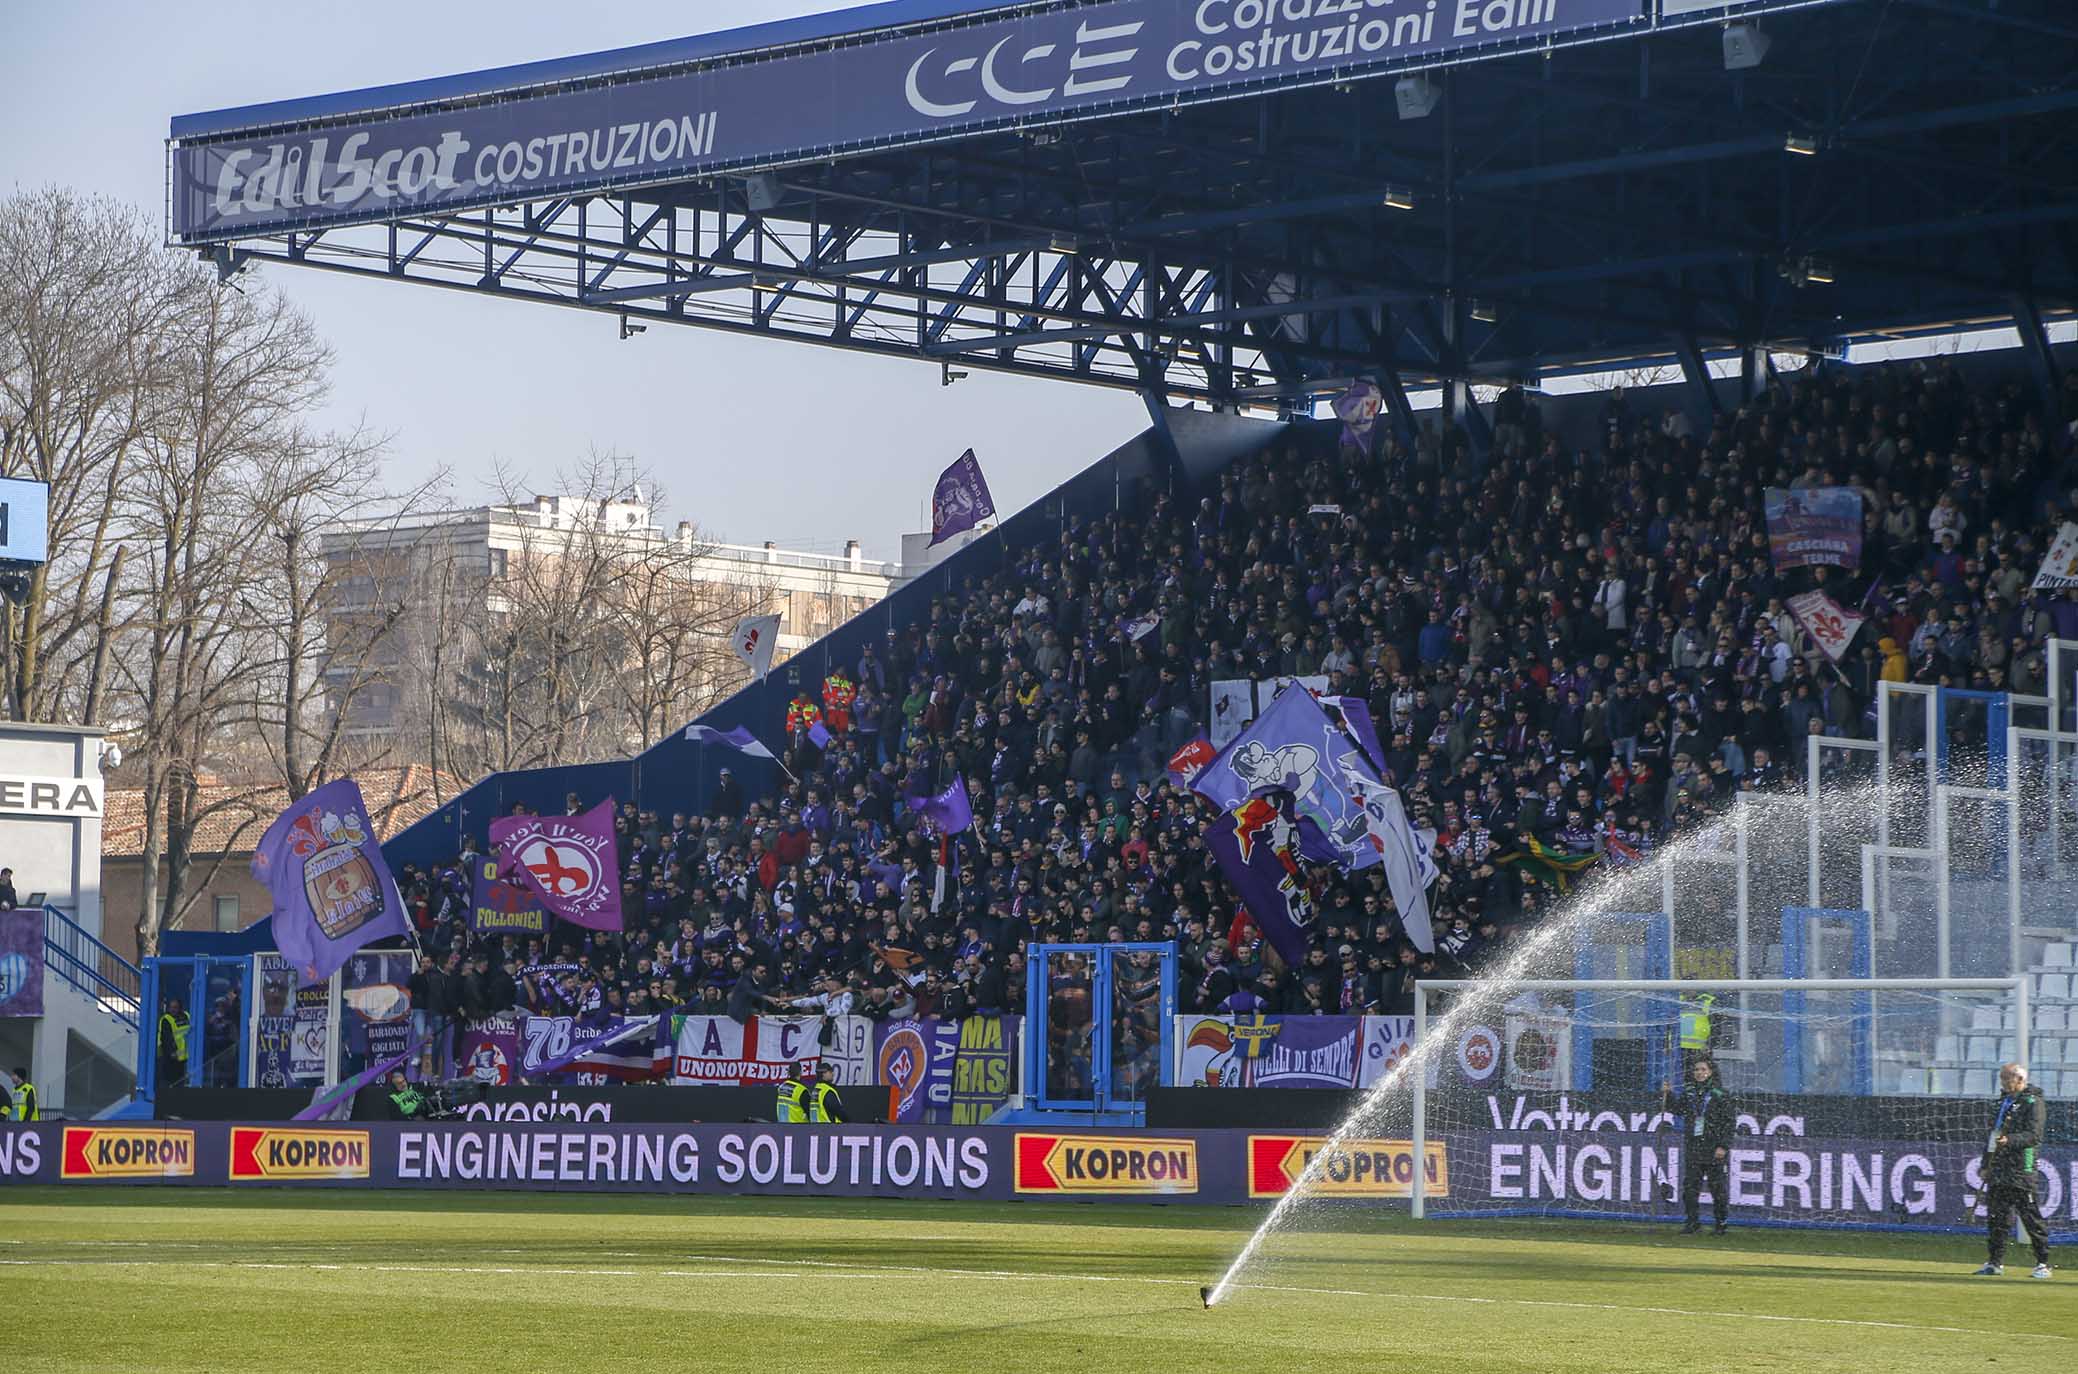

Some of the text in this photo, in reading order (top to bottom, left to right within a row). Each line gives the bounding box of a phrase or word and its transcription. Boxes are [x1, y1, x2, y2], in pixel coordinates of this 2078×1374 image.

[1166, 1, 1434, 81] Costruzioni
[474, 111, 717, 186] COSTRUZIONI
[476, 908, 543, 930] FOLLONICA
[701, 1018, 802, 1059] A C
[960, 1015, 1003, 1049] MA
[680, 1058, 817, 1080] UNONOVEDUEEI
[1294, 1050, 1307, 1072] DI
[1310, 1029, 1356, 1077] SEMPRE
[954, 1058, 1008, 1093] RAS
[0, 1131, 41, 1176] NS
[97, 1138, 188, 1166] KOPRON
[269, 1139, 363, 1168] KOPRON
[397, 1131, 989, 1187] ENGINEERING SOLUTIONS
[1066, 1148, 1188, 1181] KOPRON
[1490, 1143, 1936, 1214] ENGINERING
